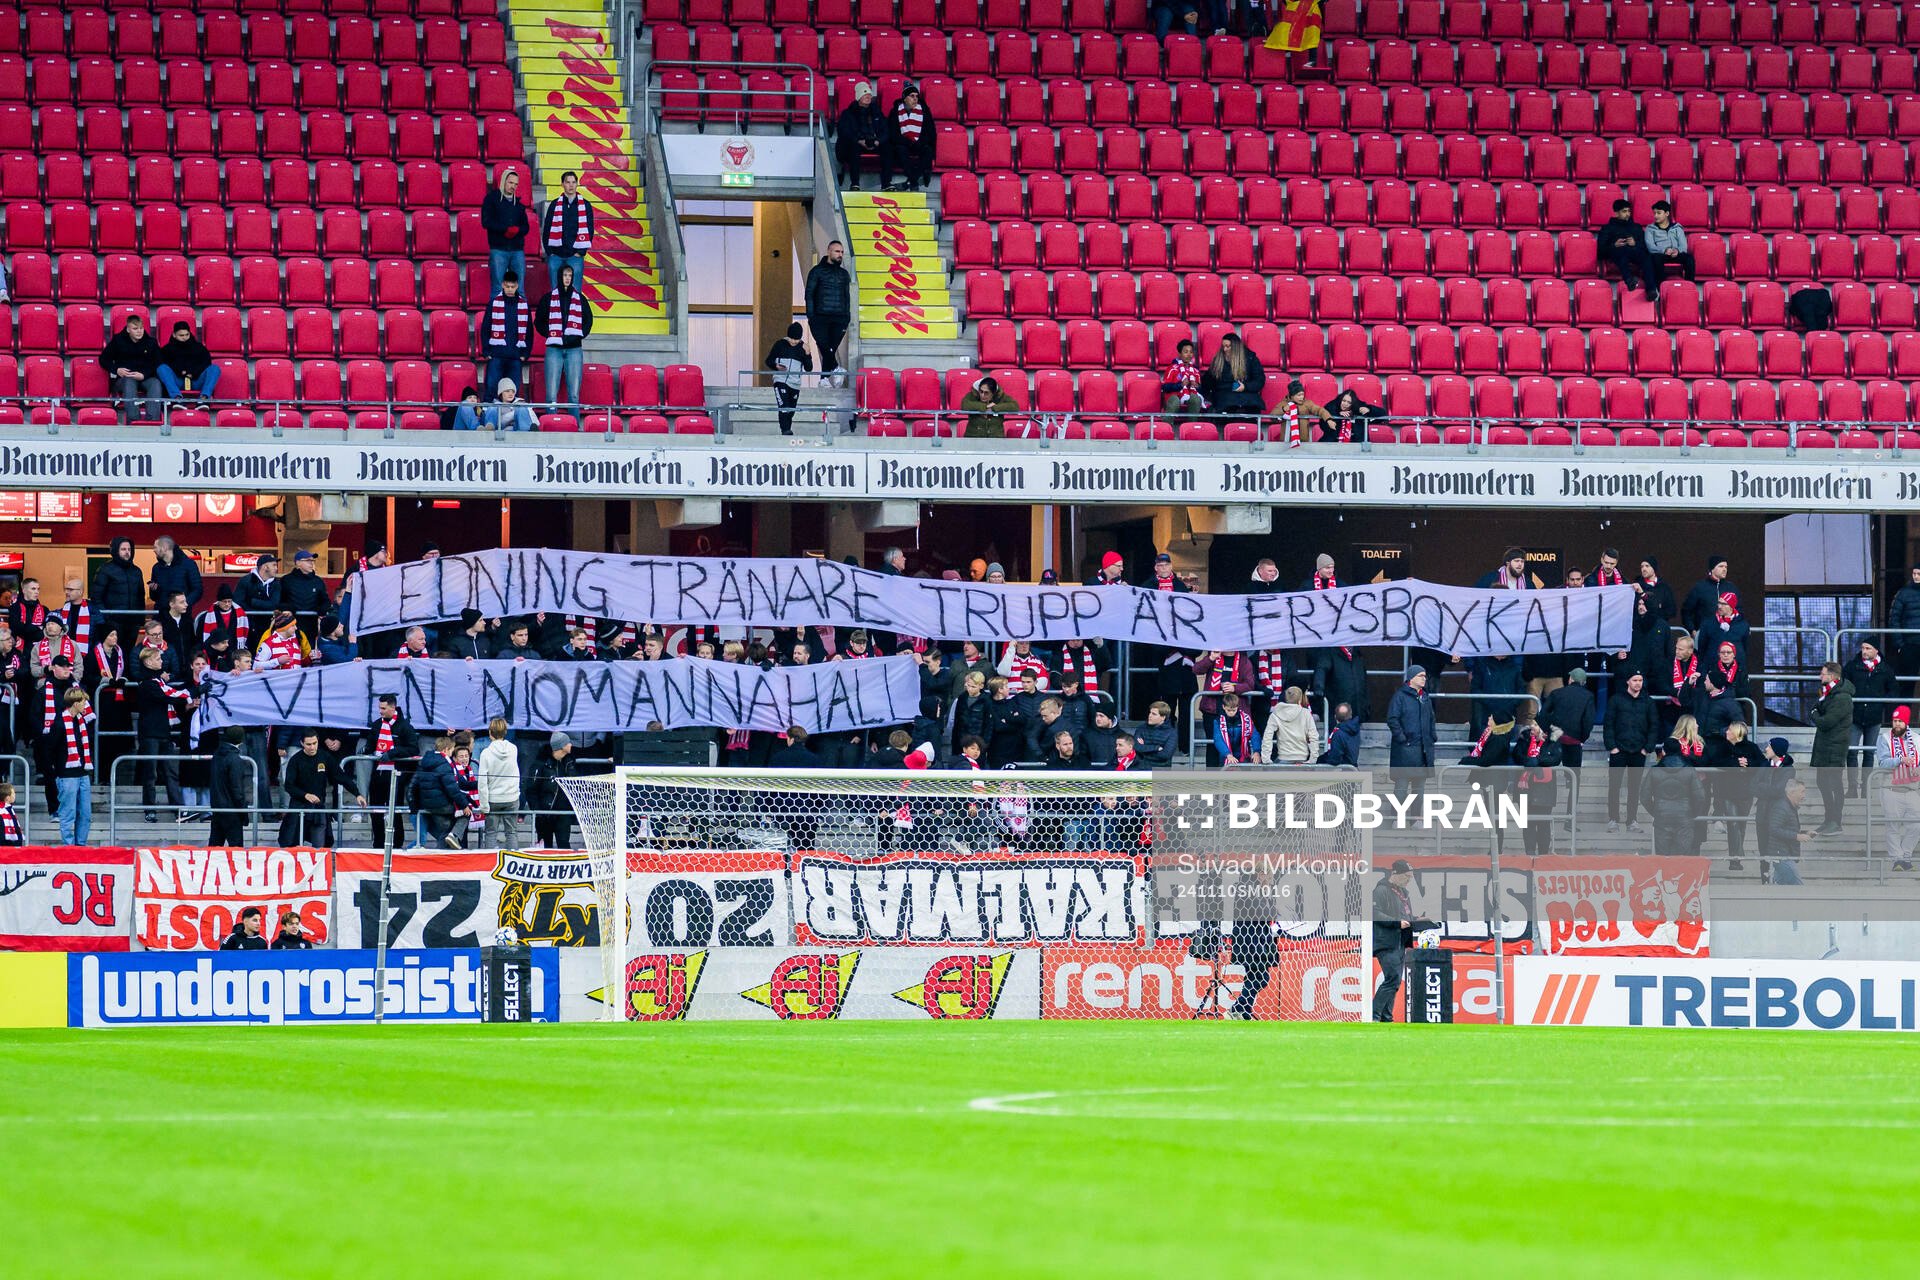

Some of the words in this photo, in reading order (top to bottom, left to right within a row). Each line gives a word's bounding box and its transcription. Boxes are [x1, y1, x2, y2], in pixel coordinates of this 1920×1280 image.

[0, 446, 153, 476] Barometern
[178, 449, 331, 479] Barometern
[357, 452, 507, 481] Barometern
[533, 454, 683, 484] Barometern
[707, 456, 856, 487] Barometern
[877, 459, 1025, 489] Barometern
[1050, 461, 1195, 491] Barometern
[1221, 464, 1365, 494] Barometern
[1391, 466, 1535, 496] Barometern
[1560, 468, 1704, 498] Barometern
[1729, 470, 1872, 500] Barometern
[1361, 550, 1402, 559] TOALETT
[1525, 553, 1557, 562] INOAR
[357, 550, 608, 632] LEDNING
[630, 559, 892, 626] TRÄNARE
[919, 583, 1102, 639] TRUPP
[1131, 586, 1207, 642] ÄR
[1245, 586, 1628, 652] FRYSBOXKALL
[260, 669, 324, 724] VI
[482, 664, 919, 733] NIOMANNAHALL
[137, 849, 329, 896] KURVAN
[506, 859, 546, 881] TIFO
[52, 871, 116, 926] RC
[801, 860, 1134, 942] KALMAR
[1538, 874, 1626, 901] brothers
[353, 879, 482, 949] 24
[645, 878, 774, 947] 20
[1546, 899, 1621, 955] red
[503, 962, 520, 1021] SELECT
[1426, 965, 1441, 1023] SELECT
